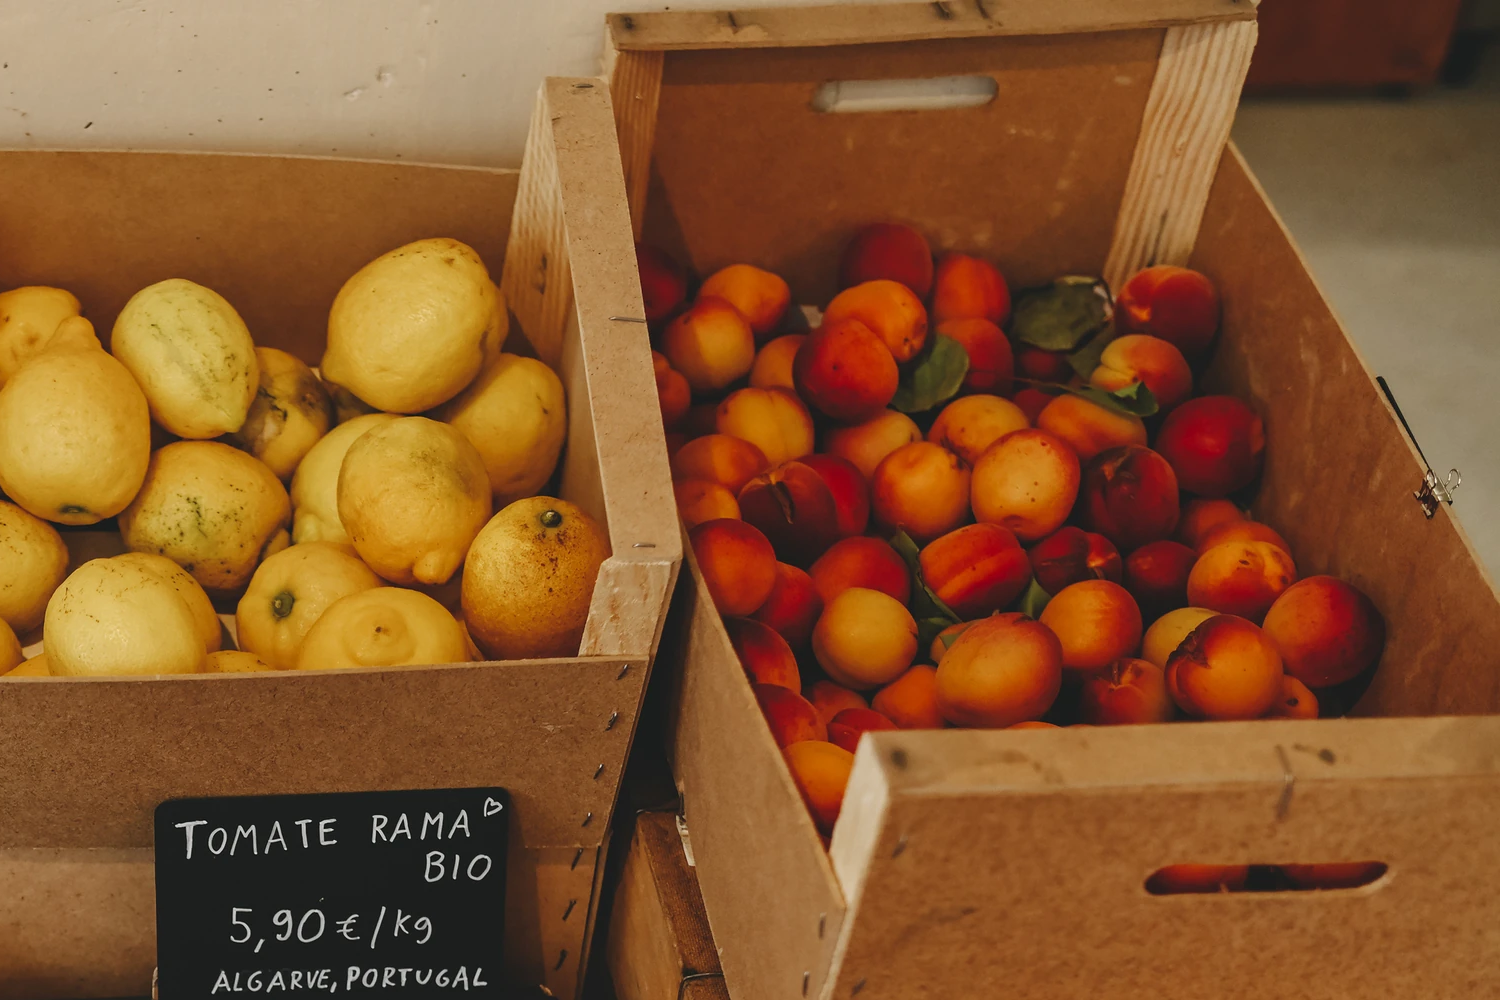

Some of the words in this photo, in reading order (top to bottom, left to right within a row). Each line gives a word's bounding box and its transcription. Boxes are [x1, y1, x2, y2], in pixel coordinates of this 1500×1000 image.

[174, 817, 338, 860] TOMATE
[371, 809, 472, 844] RAMA
[423, 850, 493, 883] BIO
[345, 965, 489, 992] PORTUGAL
